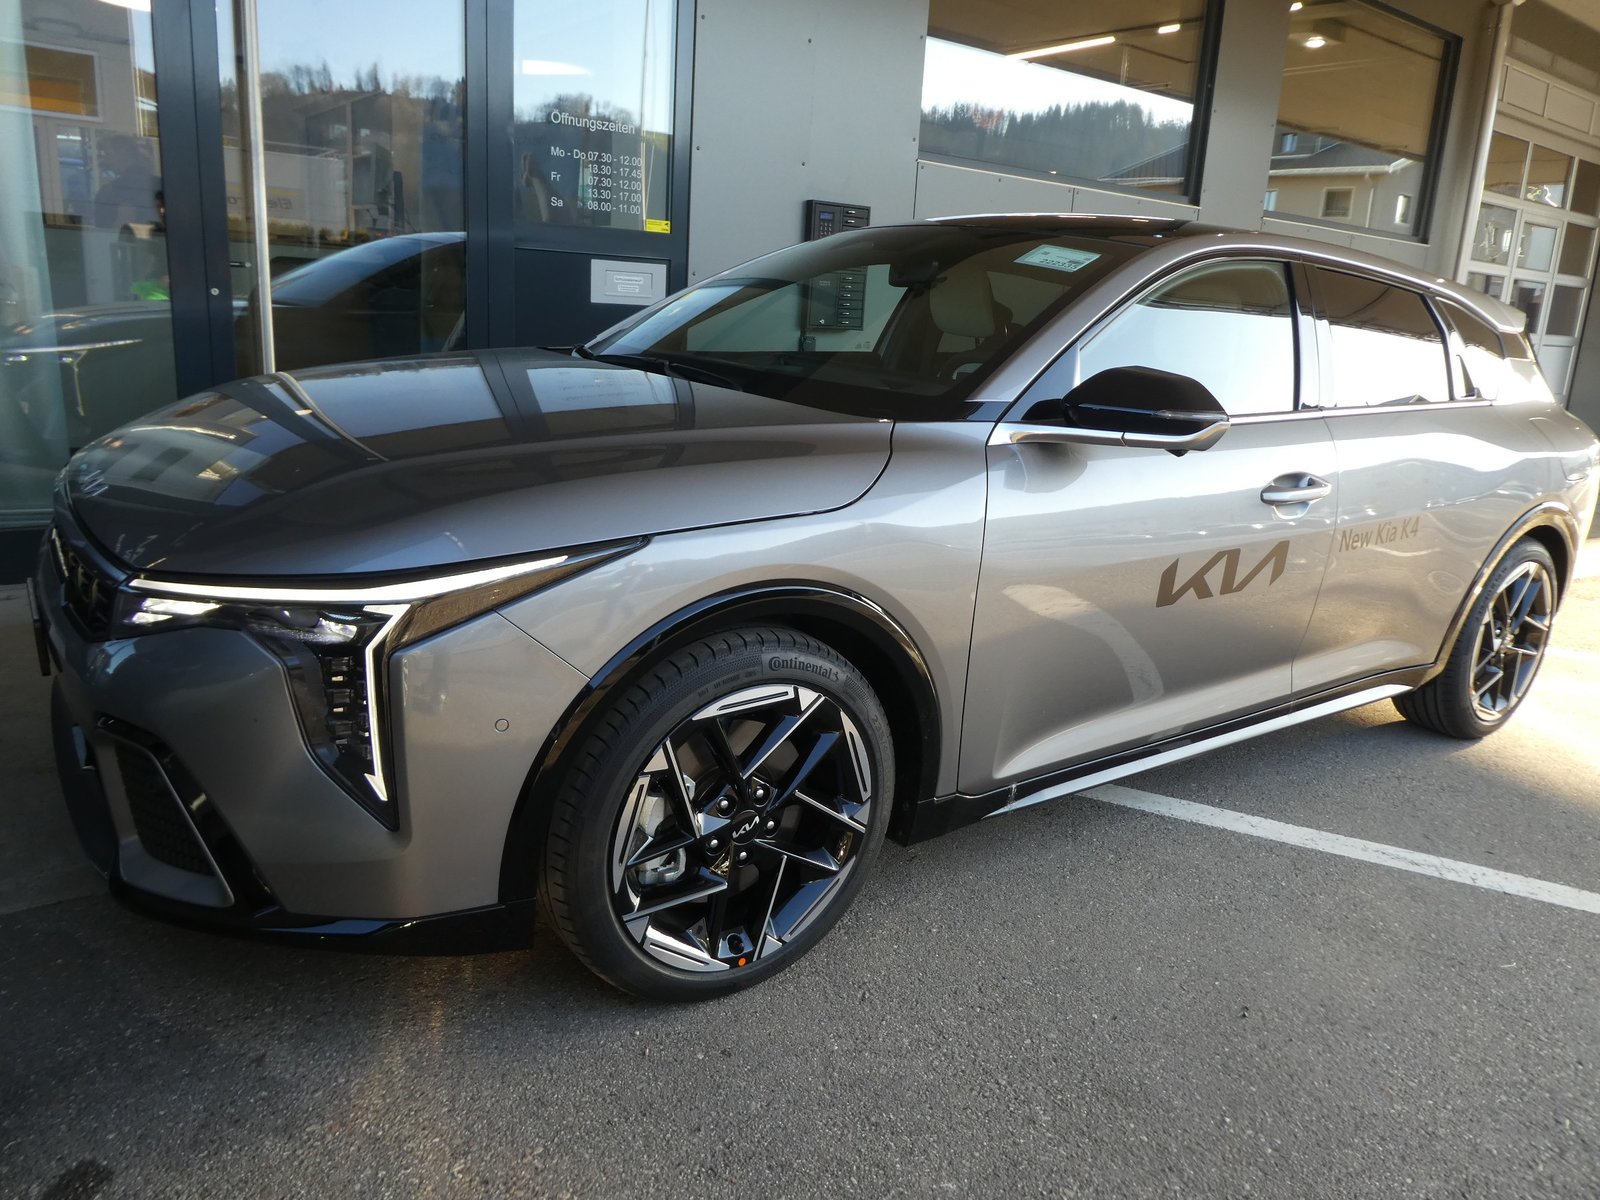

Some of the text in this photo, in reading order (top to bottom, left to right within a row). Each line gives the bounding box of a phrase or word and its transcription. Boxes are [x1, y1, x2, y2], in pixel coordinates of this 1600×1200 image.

[550, 108, 636, 135] Öffnungszeiten
[550, 146, 565, 157] Mo
[573, 149, 586, 160] Do
[587, 151, 612, 163] 07.30
[620, 155, 643, 167] 12.00
[550, 171, 561, 182] Fr
[587, 175, 612, 188] 07.30
[619, 179, 642, 191] 12.00
[588, 163, 612, 175] 13.30
[619, 167, 642, 179] 17.45
[550, 196, 563, 207] Sa
[587, 200, 612, 212] 08.00
[618, 203, 641, 215] 11.00
[588, 188, 611, 200] 13.30
[619, 191, 642, 203] 17.00
[1338, 516, 1420, 553] New Kia K4
[1155, 540, 1290, 608] KIA
[768, 656, 832, 680] Continental
[731, 815, 760, 839] KIA
